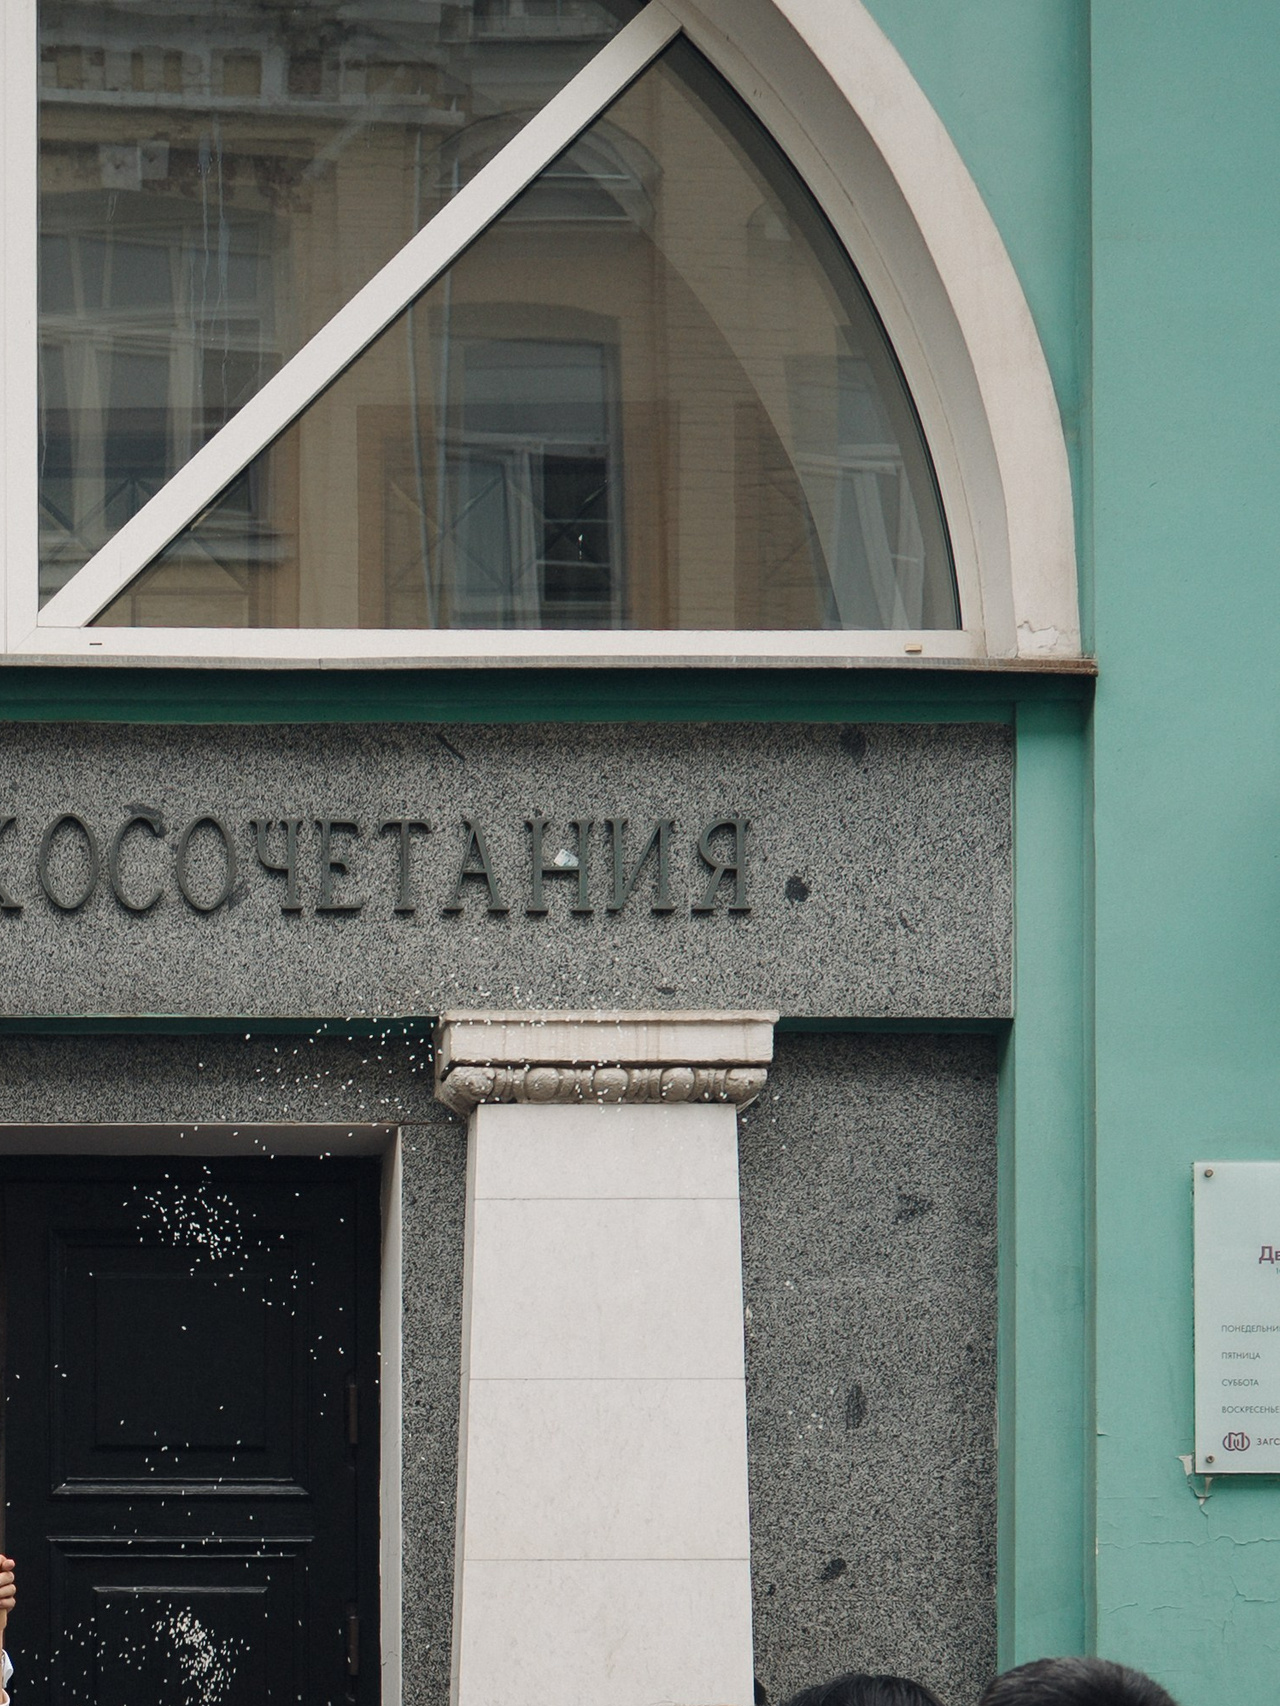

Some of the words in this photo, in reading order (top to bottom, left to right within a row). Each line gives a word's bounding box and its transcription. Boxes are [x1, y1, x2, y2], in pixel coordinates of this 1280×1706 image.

[1221, 1324, 1280, 1334] ПОНЕДЕЛЬНИ
[1221, 1351, 1261, 1360] ПЯТНИЦА
[1221, 1378, 1260, 1387] СУББОТА
[1221, 1405, 1280, 1414] ВОСКРЕСЕНЬЕ
[1256, 1437, 1280, 1446] ЗАГС
